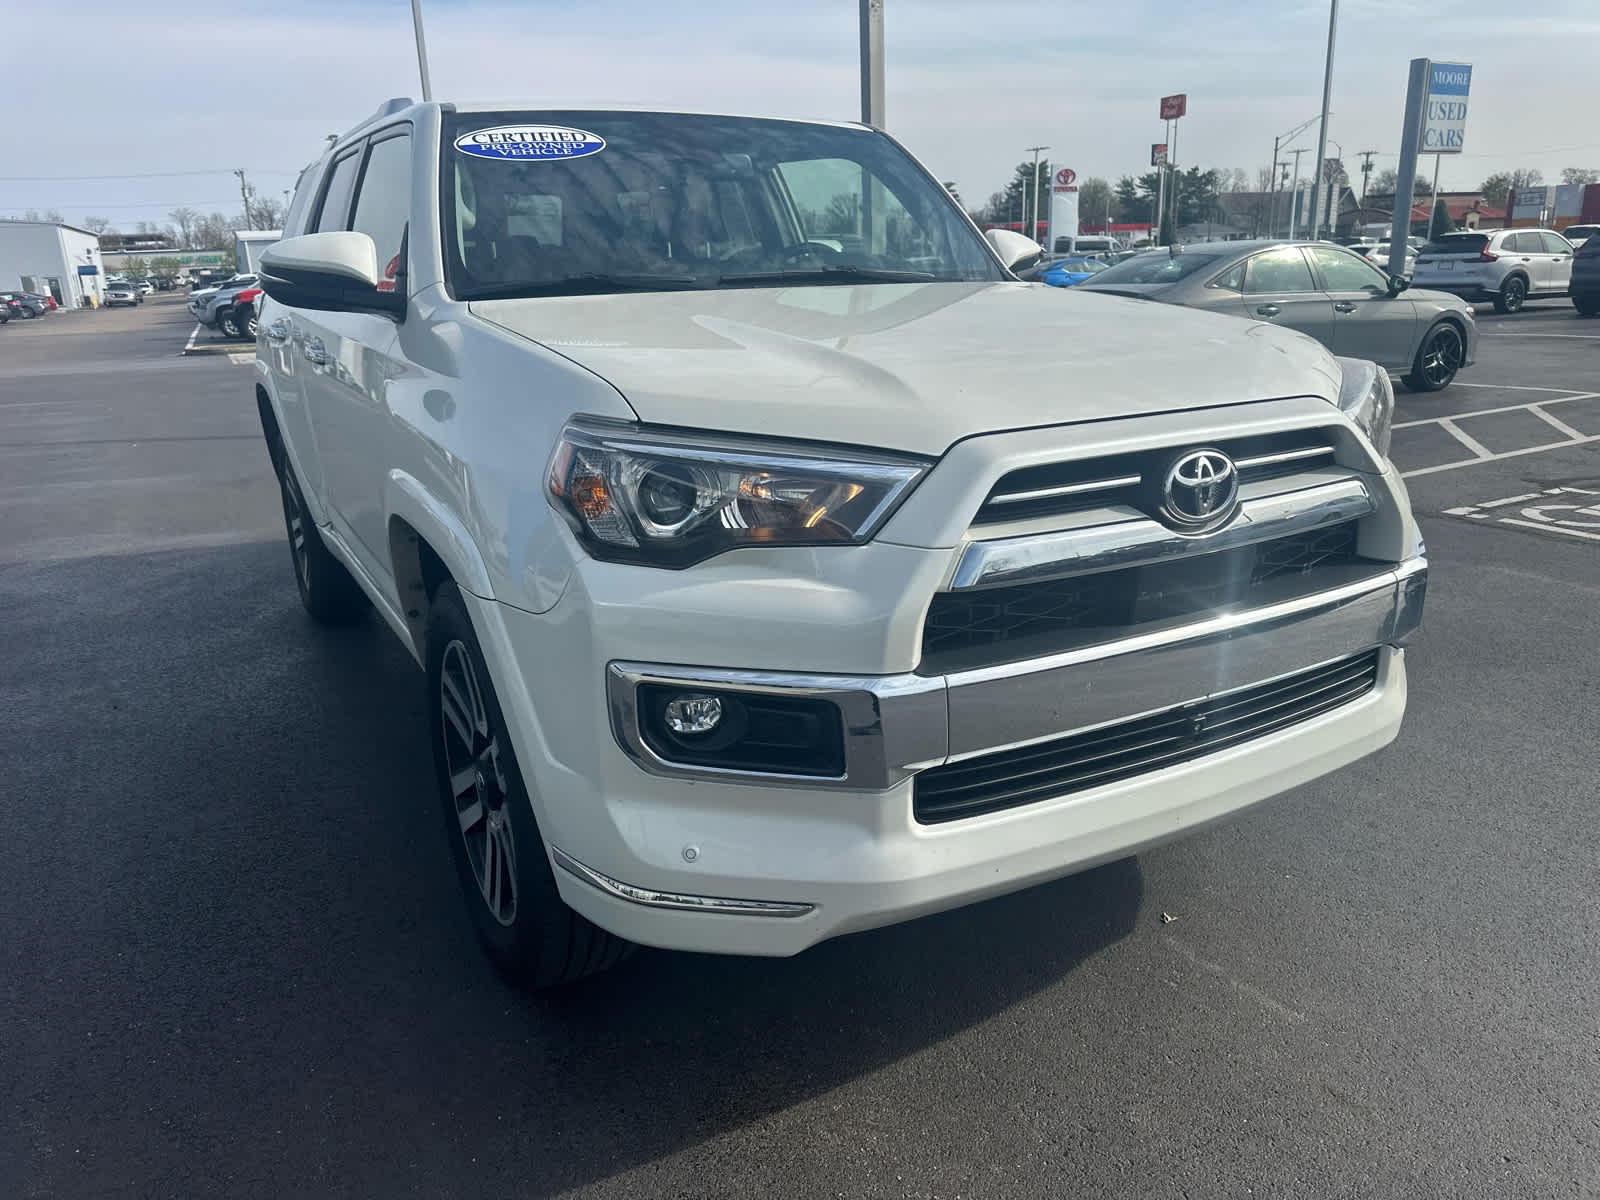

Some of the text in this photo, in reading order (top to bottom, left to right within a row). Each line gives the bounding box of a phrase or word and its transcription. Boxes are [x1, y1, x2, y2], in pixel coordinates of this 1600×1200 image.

[1433, 72, 1469, 85] MOORE
[1429, 101, 1467, 120] USED
[472, 132, 587, 143] CERTIFIED
[1424, 128, 1464, 147] CARS
